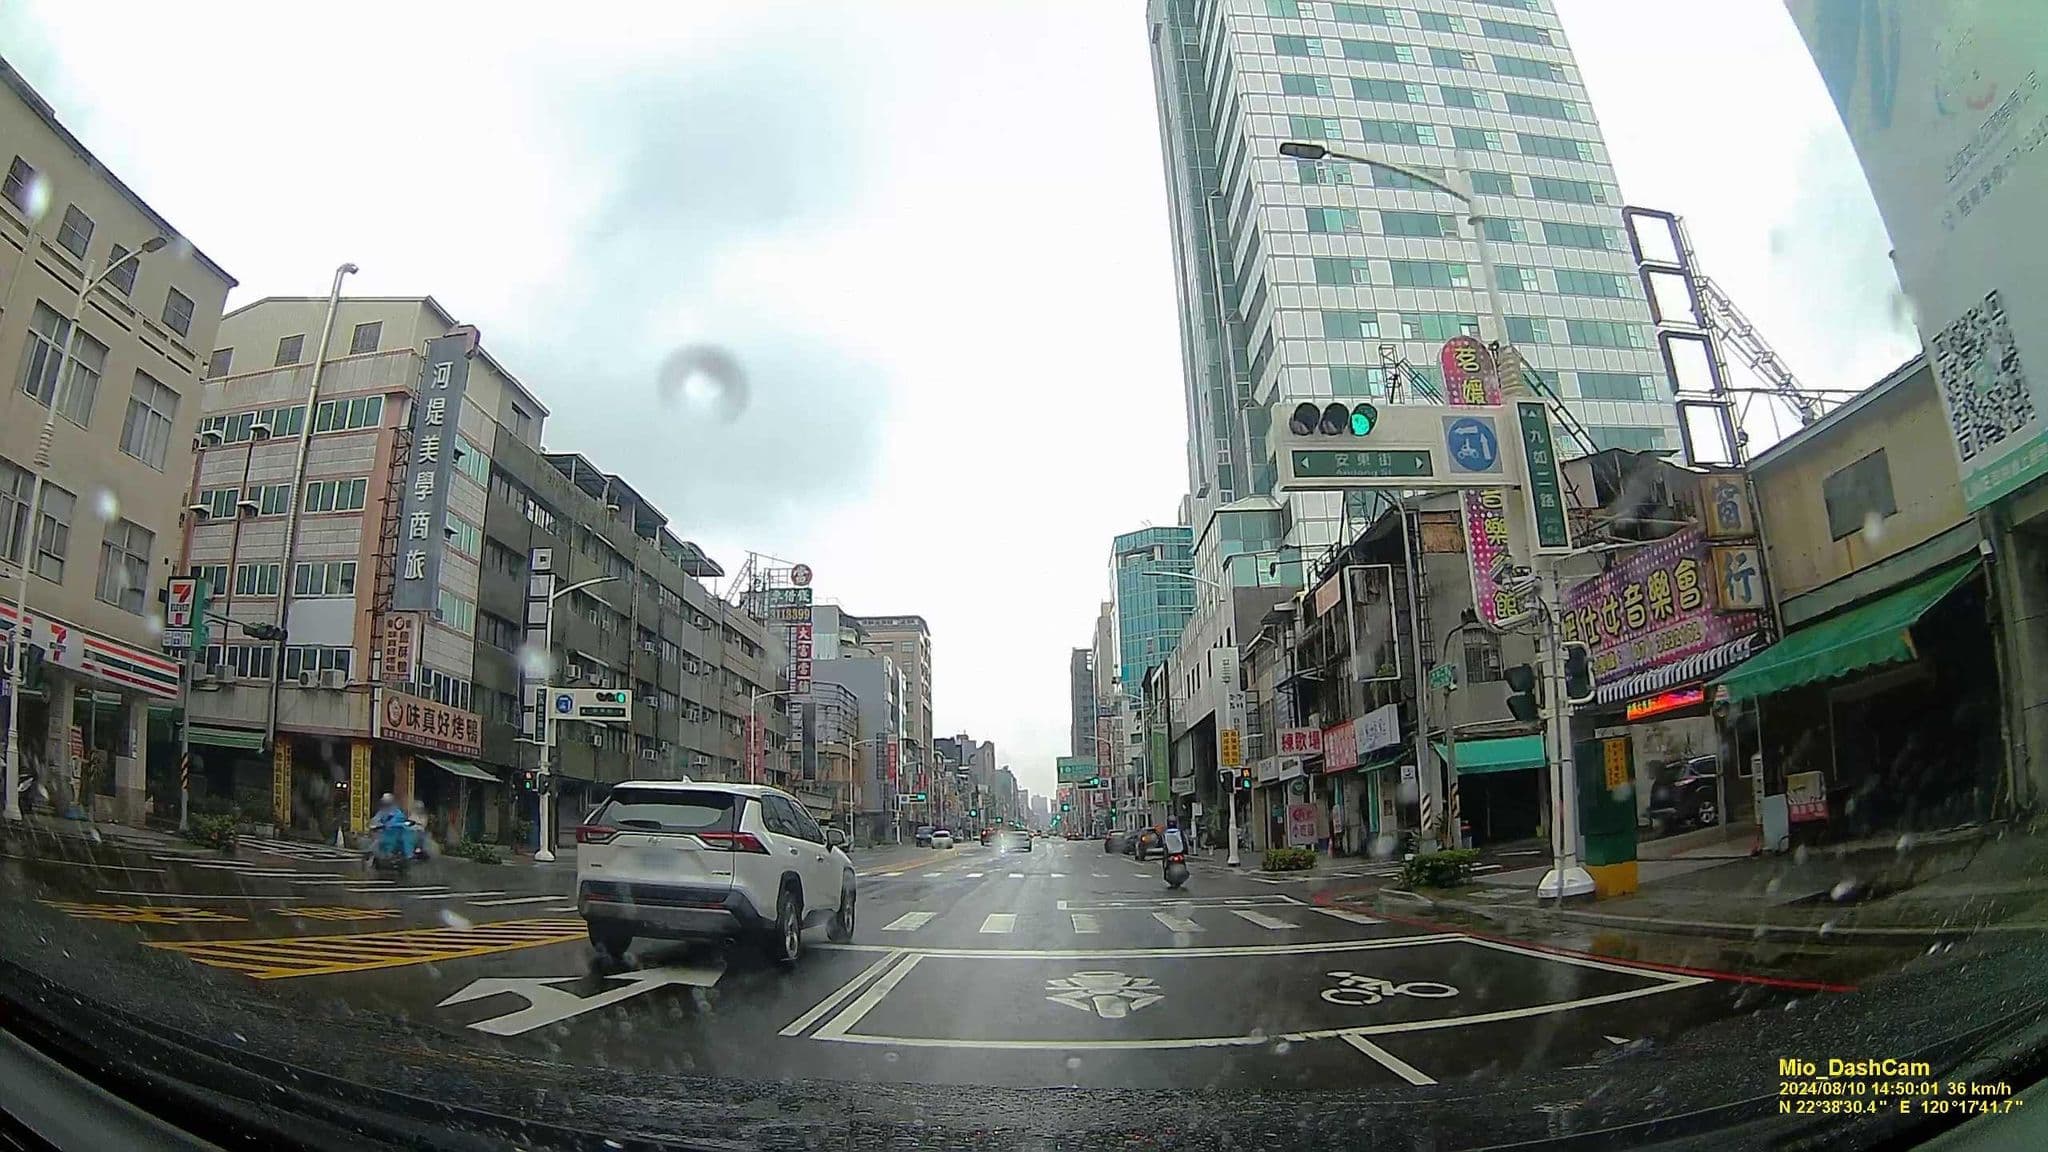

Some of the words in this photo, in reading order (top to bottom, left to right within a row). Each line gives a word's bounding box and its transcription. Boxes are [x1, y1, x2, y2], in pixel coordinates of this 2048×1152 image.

[1335, 453, 1391, 467] 安東街
[1530, 429, 1555, 508] 九如二路
[406, 703, 478, 744] 味真好烤鴨
